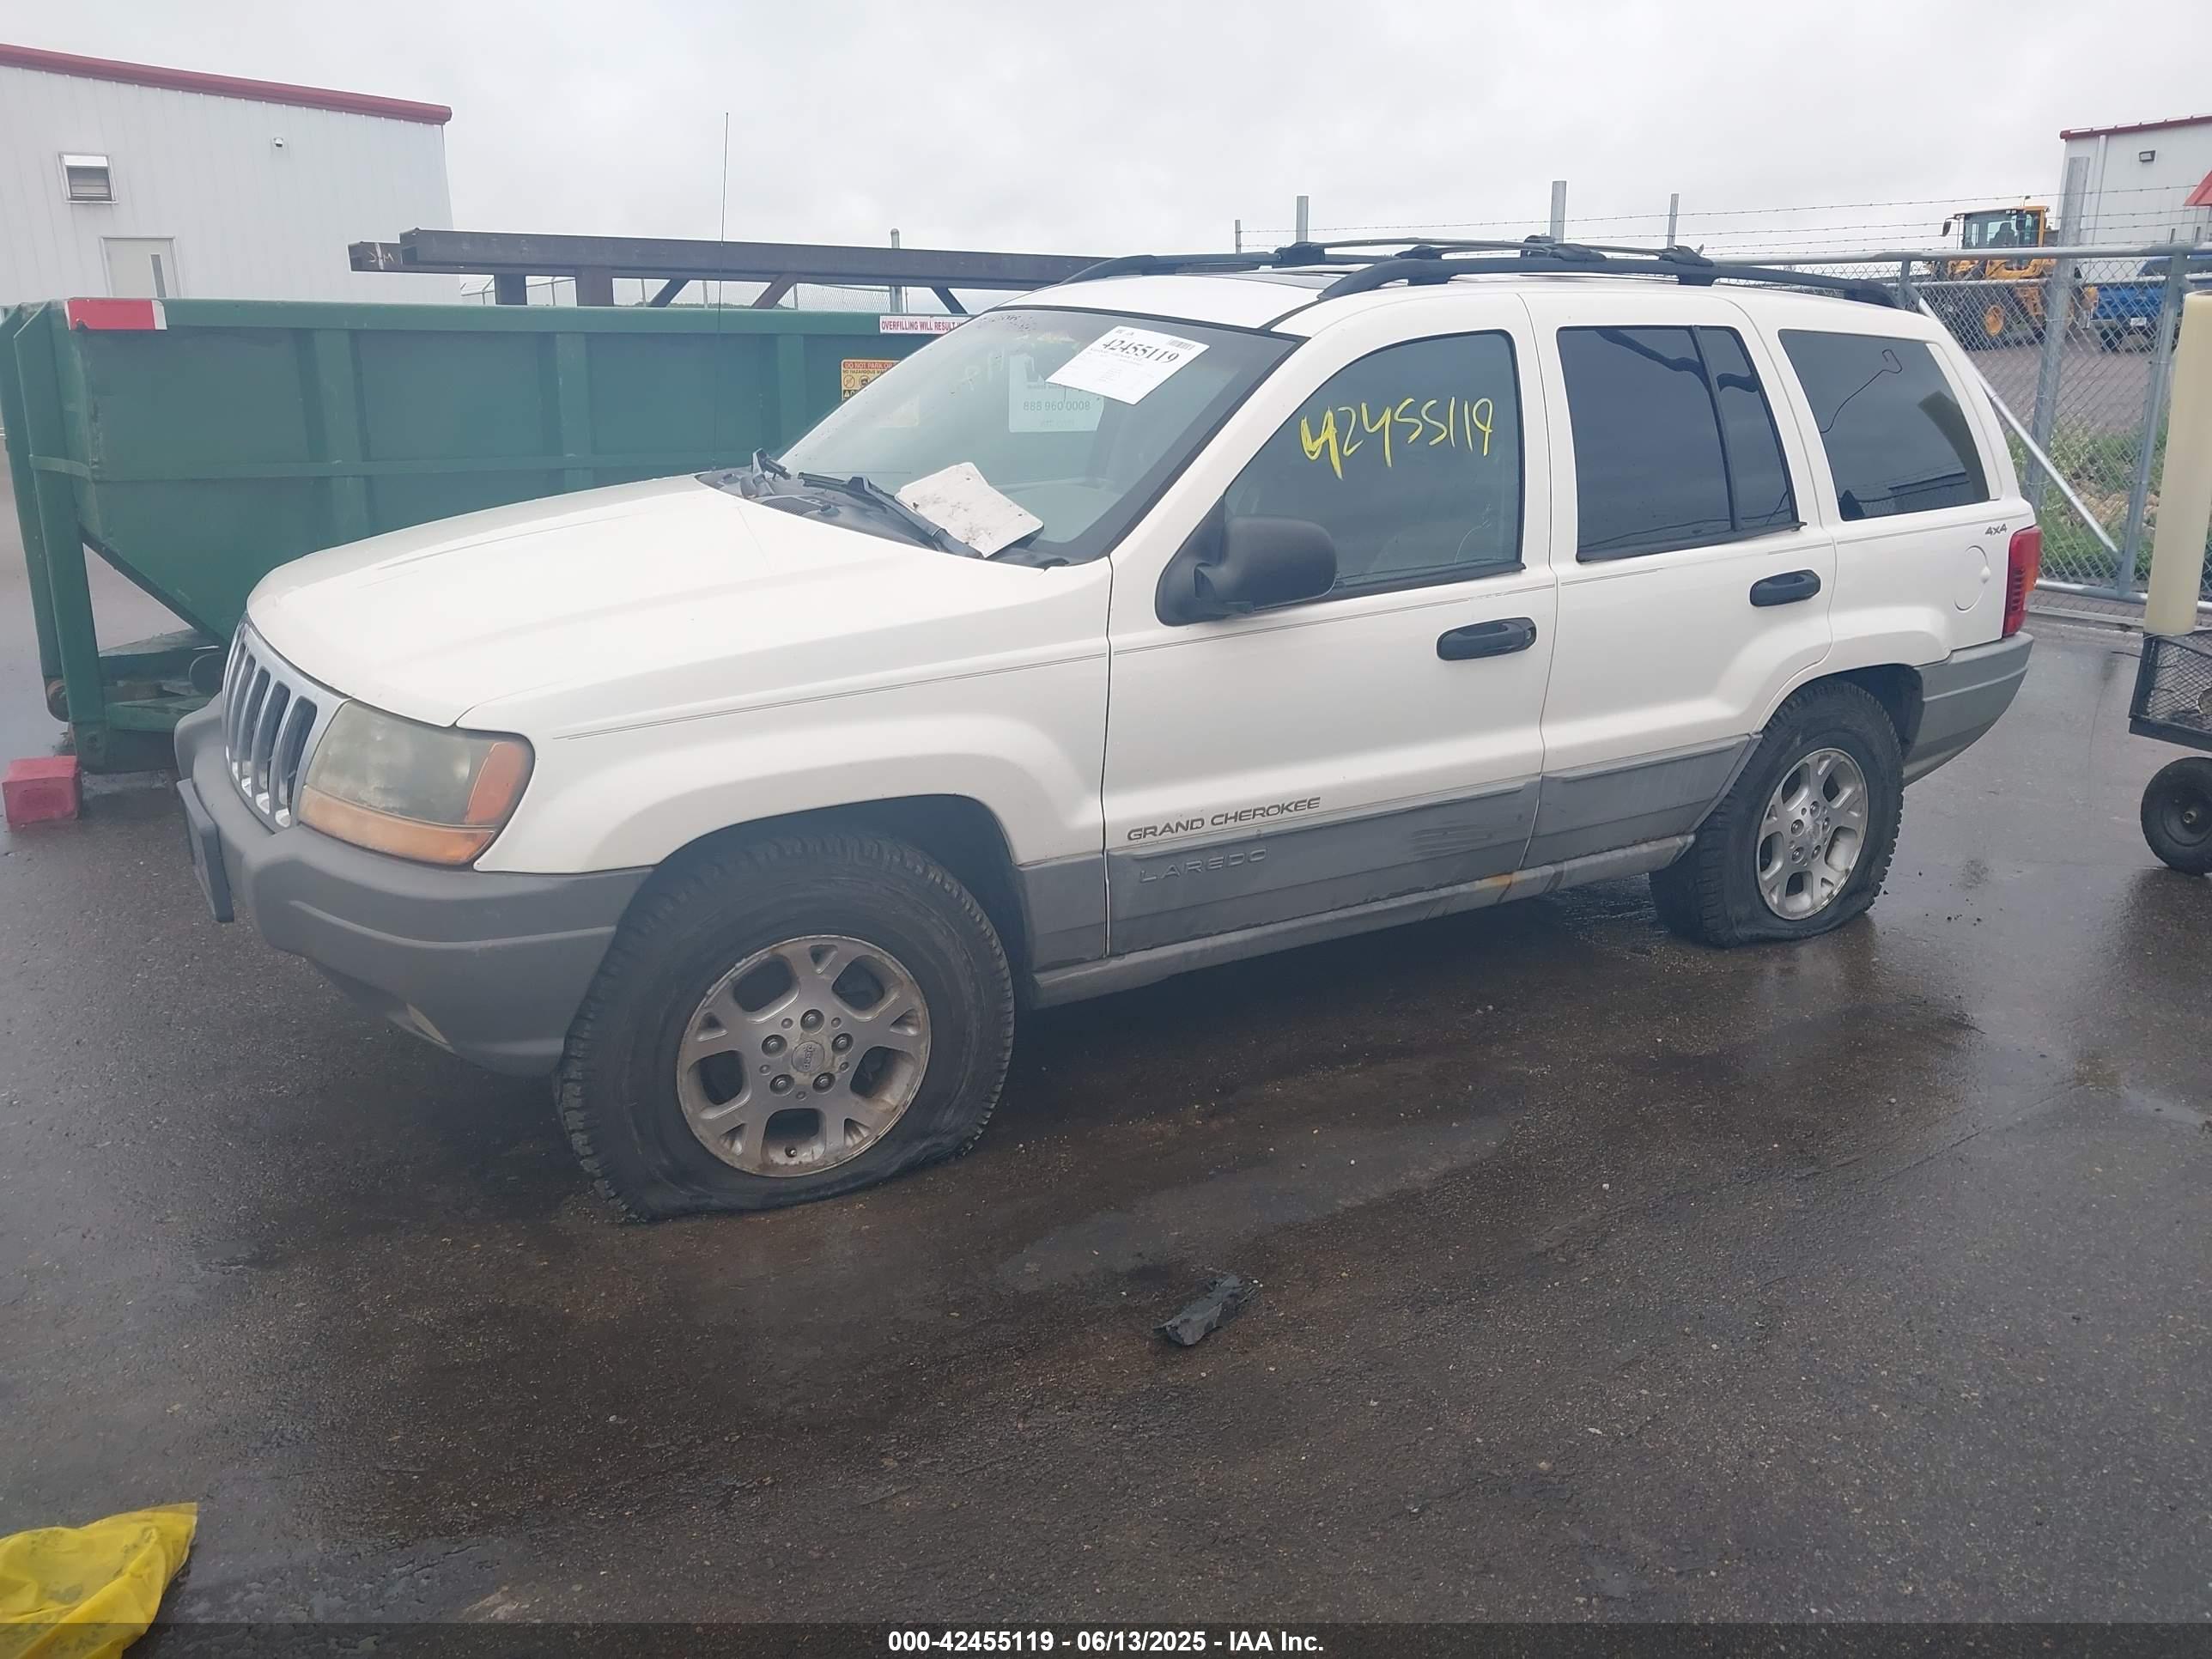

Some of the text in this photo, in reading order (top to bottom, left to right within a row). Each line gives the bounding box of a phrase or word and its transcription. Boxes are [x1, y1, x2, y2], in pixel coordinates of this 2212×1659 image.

[881, 321, 918, 331] OVERFILLING
[920, 321, 933, 331] WILL
[934, 321, 956, 331] RESULT
[1103, 337, 1180, 363] 42455119
[1300, 397, 1493, 480] 42455119
[1127, 797, 1322, 842] GRAND CHEROKEE
[1139, 848, 1267, 884] LAREDO
